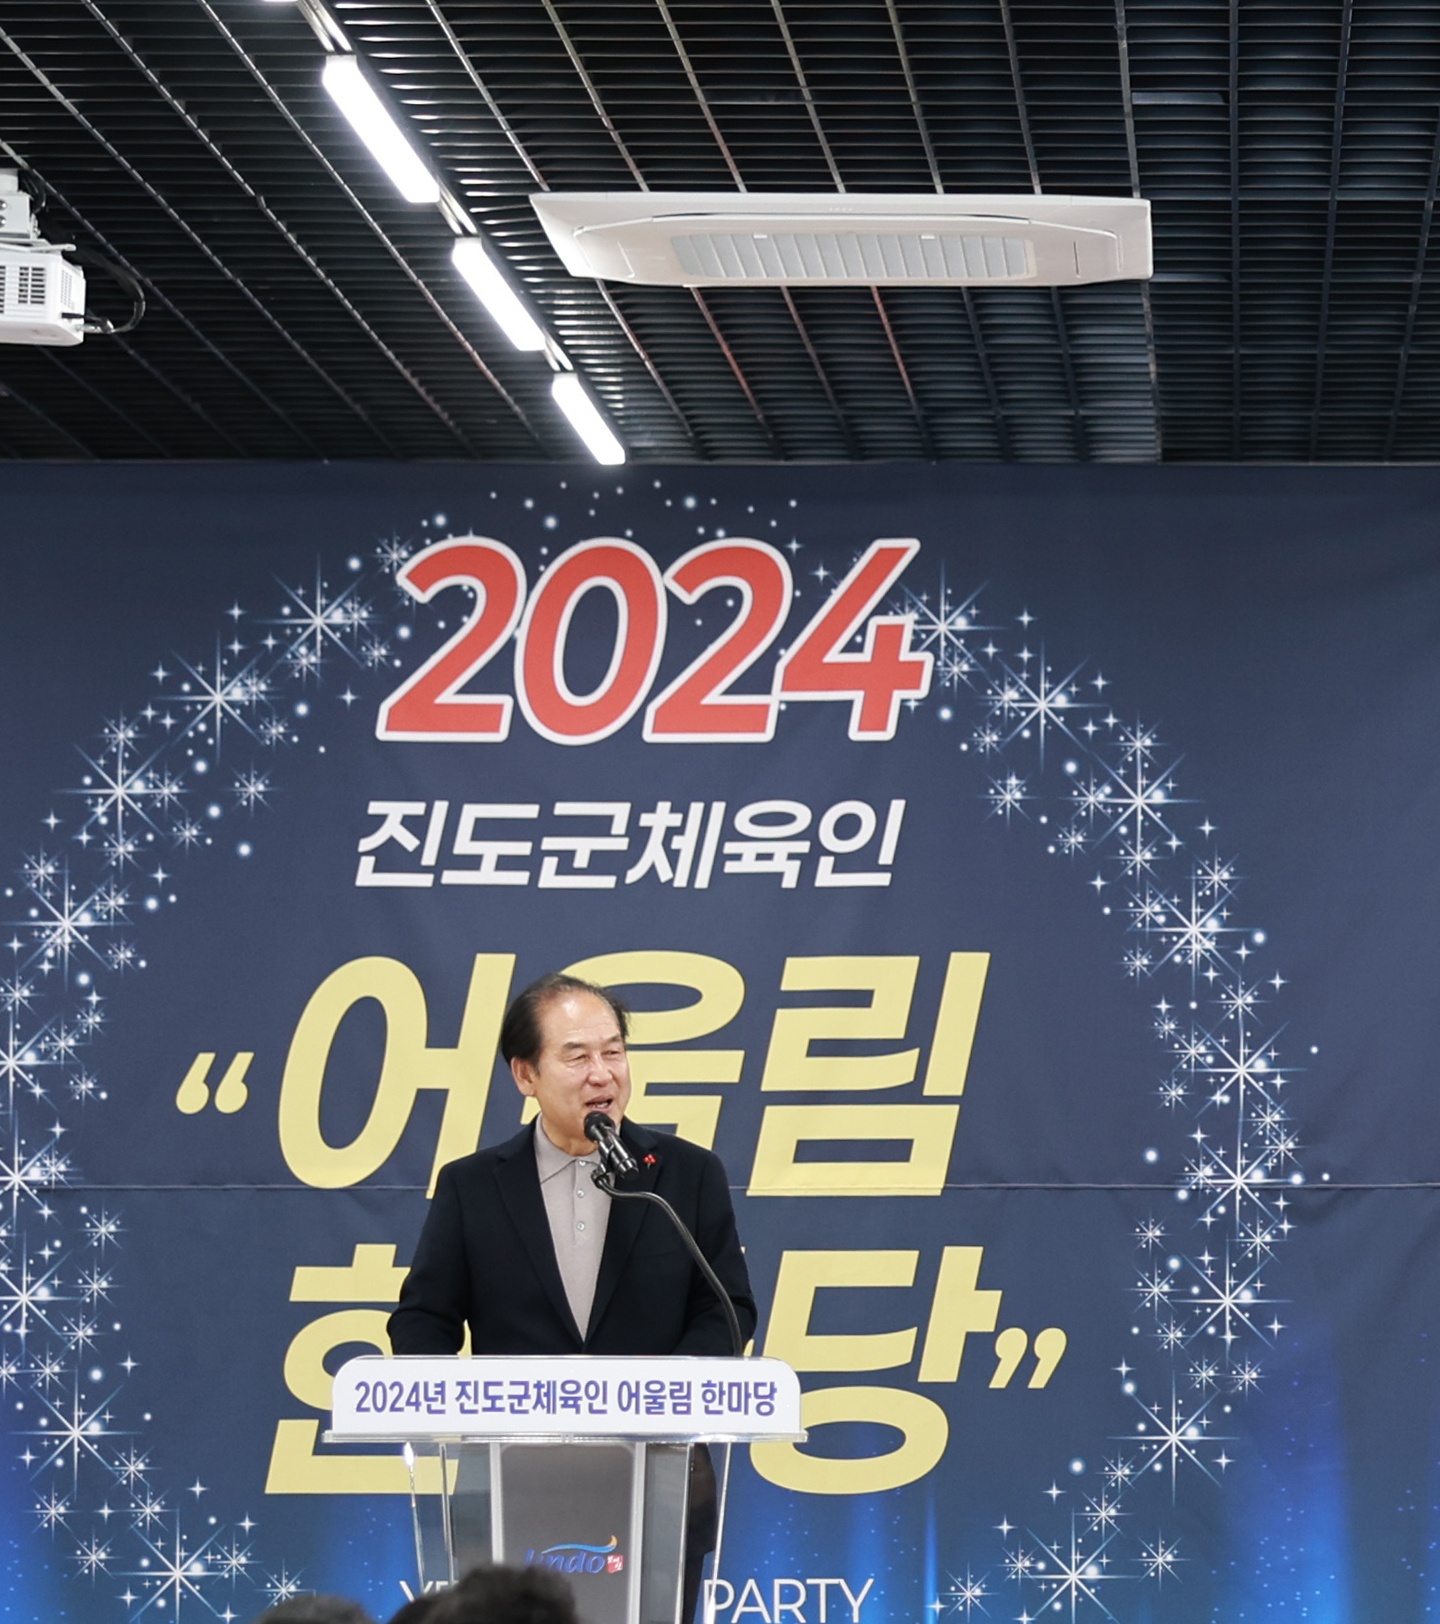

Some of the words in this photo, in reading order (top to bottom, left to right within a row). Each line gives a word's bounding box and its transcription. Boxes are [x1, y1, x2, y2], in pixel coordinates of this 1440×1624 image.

[376, 534, 934, 745] 2024
[355, 797, 907, 890] 진도군체육인
[265, 1243, 1067, 1494] 한당”
[355, 1379, 447, 1416] 2024년
[454, 1379, 609, 1417] 진도군체육인
[616, 1379, 692, 1416] 어울림
[701, 1378, 778, 1418] 한마당
[703, 1578, 875, 1624] PARTY
